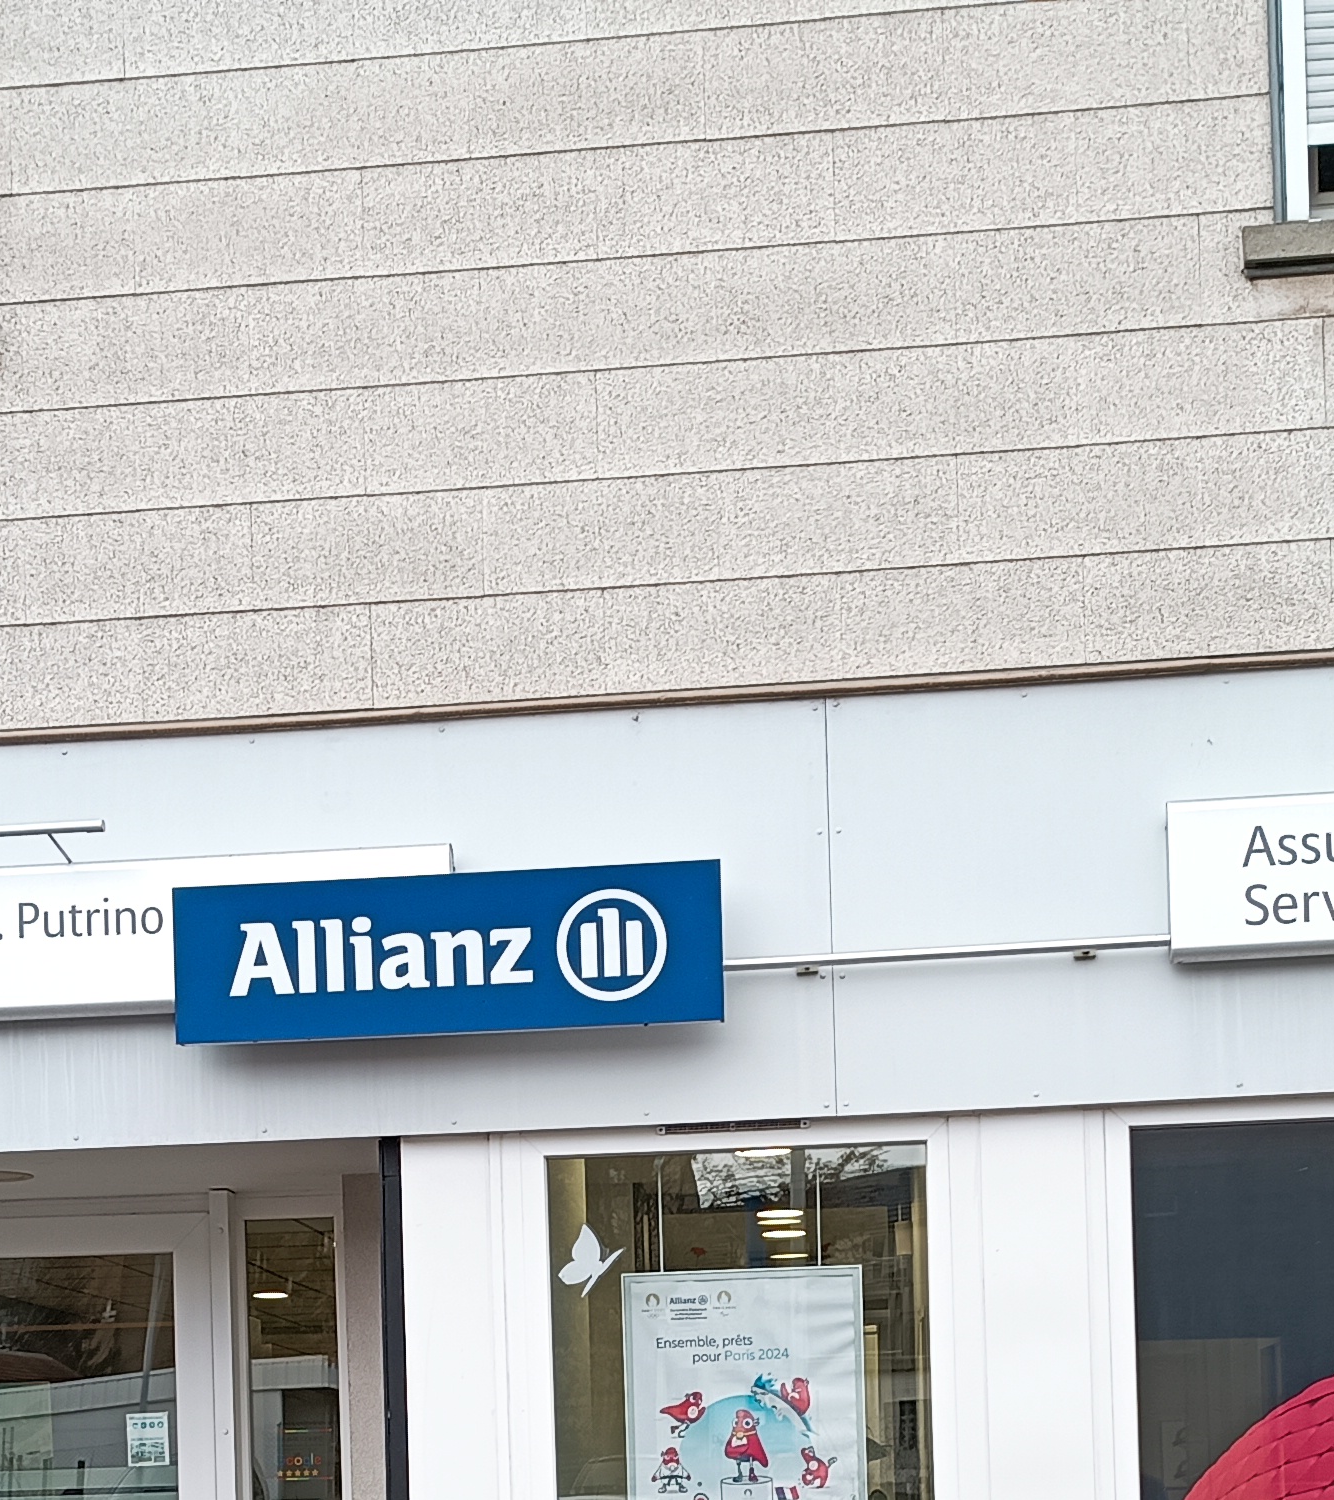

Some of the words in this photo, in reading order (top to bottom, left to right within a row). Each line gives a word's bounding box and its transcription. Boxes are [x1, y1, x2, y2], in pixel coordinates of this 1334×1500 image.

[18, 897, 165, 939] Putrino
[229, 916, 534, 997] Allianz
[656, 1335, 719, 1349] Ensemble,
[722, 1334, 753, 1348] prêts
[693, 1352, 721, 1364] pour
[725, 1349, 755, 1361] Paris
[758, 1347, 790, 1360] 2024
